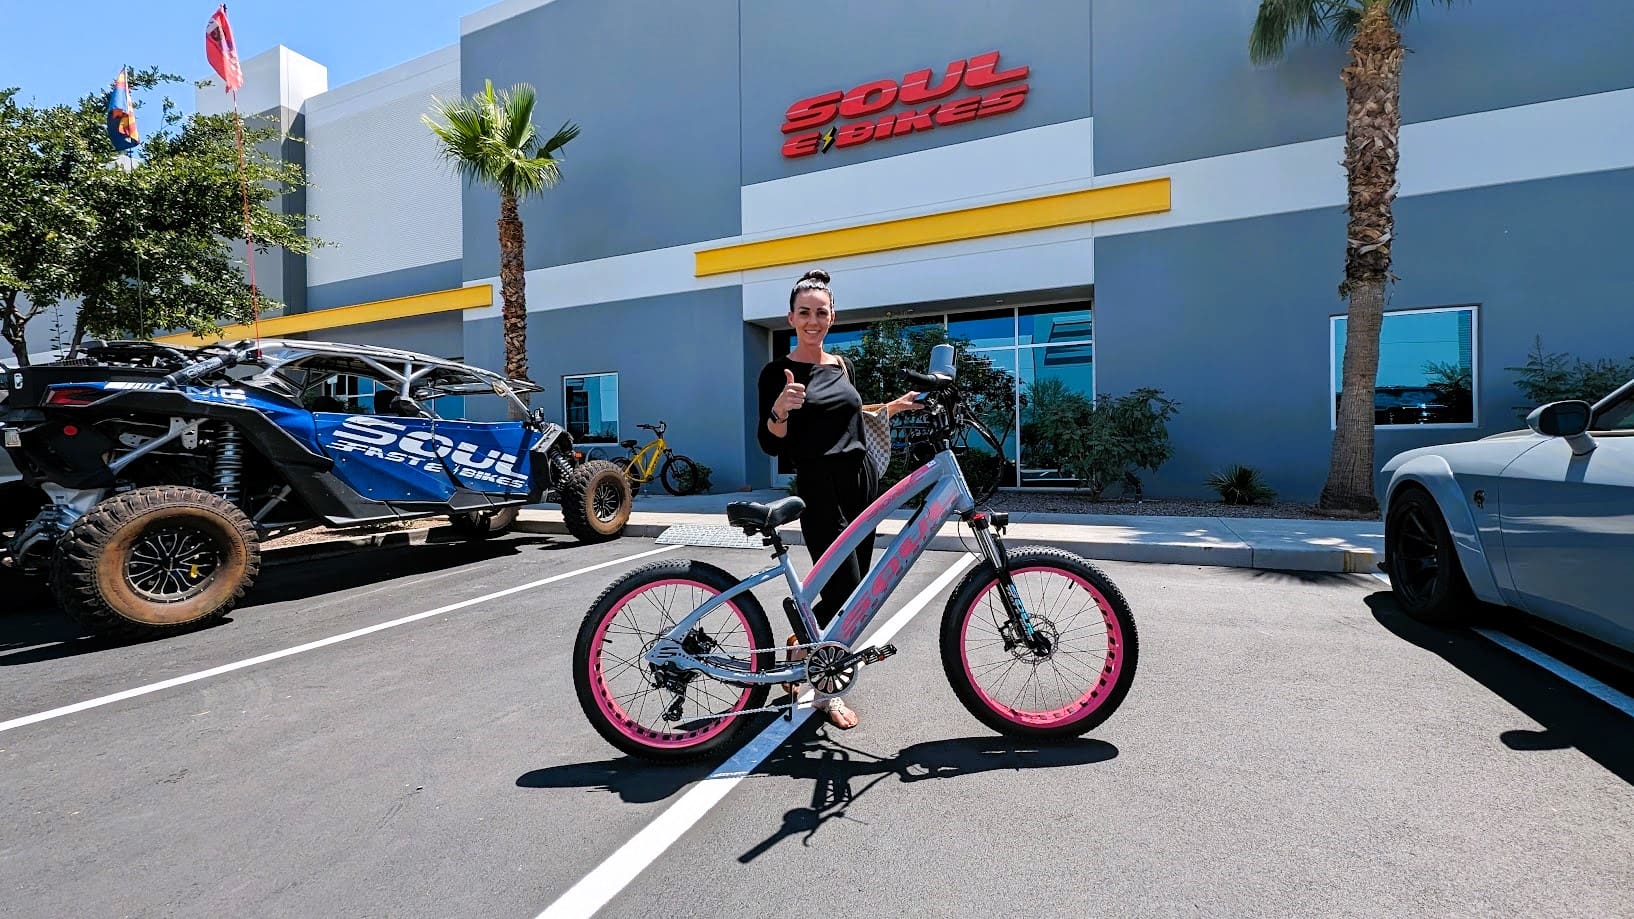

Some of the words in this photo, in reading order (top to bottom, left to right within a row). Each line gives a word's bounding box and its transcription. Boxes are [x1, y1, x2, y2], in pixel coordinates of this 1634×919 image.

[781, 51, 1029, 134] SOUL
[835, 84, 1029, 149] BIKES
[326, 439, 425, 466] FAST
[458, 467, 526, 489] BIKES
[333, 415, 528, 479] SOUL
[841, 490, 957, 639] SOUL
